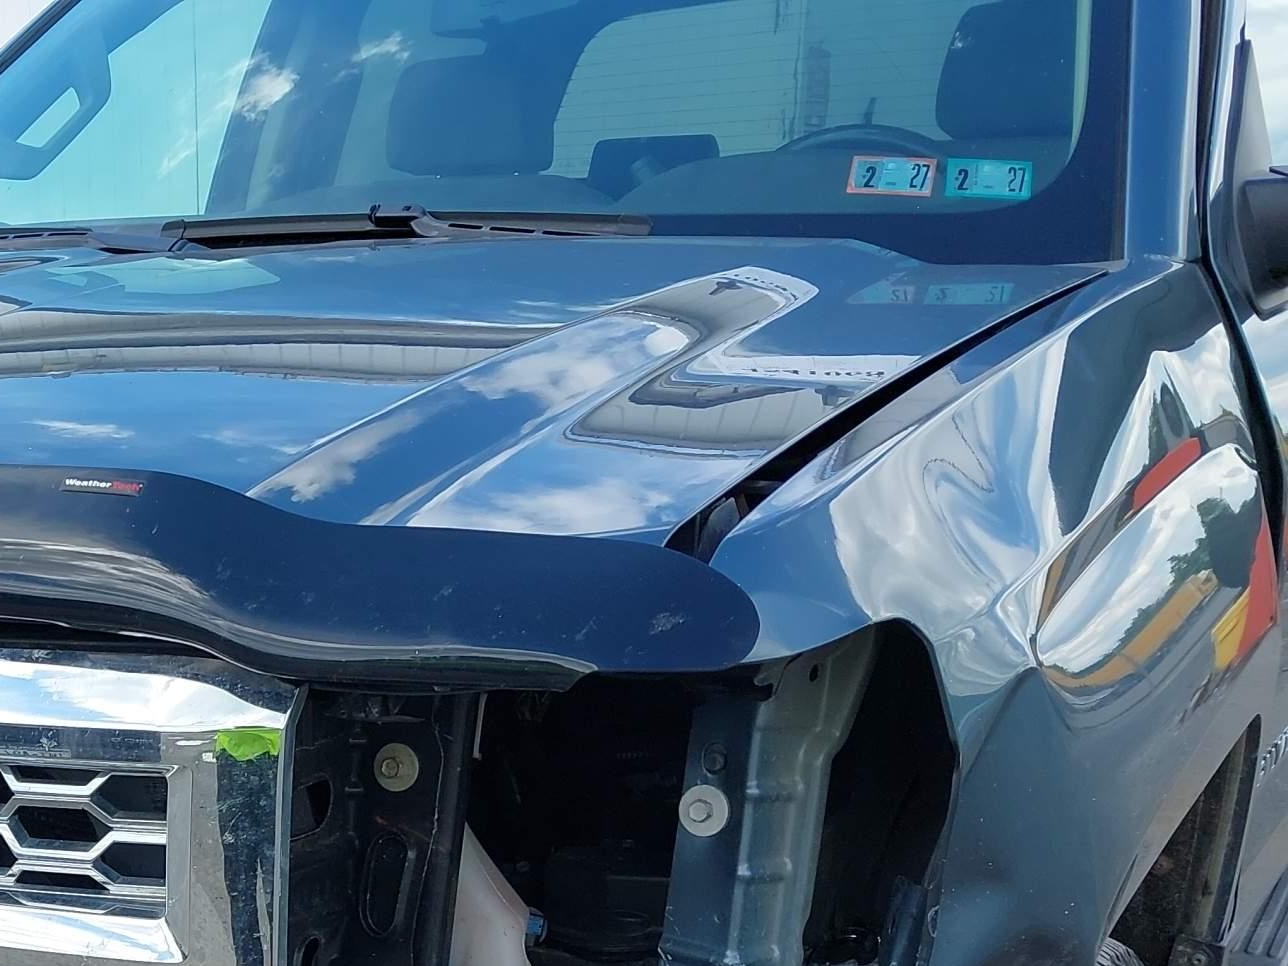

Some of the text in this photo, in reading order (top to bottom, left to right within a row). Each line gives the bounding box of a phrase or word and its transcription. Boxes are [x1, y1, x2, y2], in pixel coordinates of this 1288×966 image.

[863, 163, 931, 190] 2 27
[957, 166, 1027, 192] 2 27
